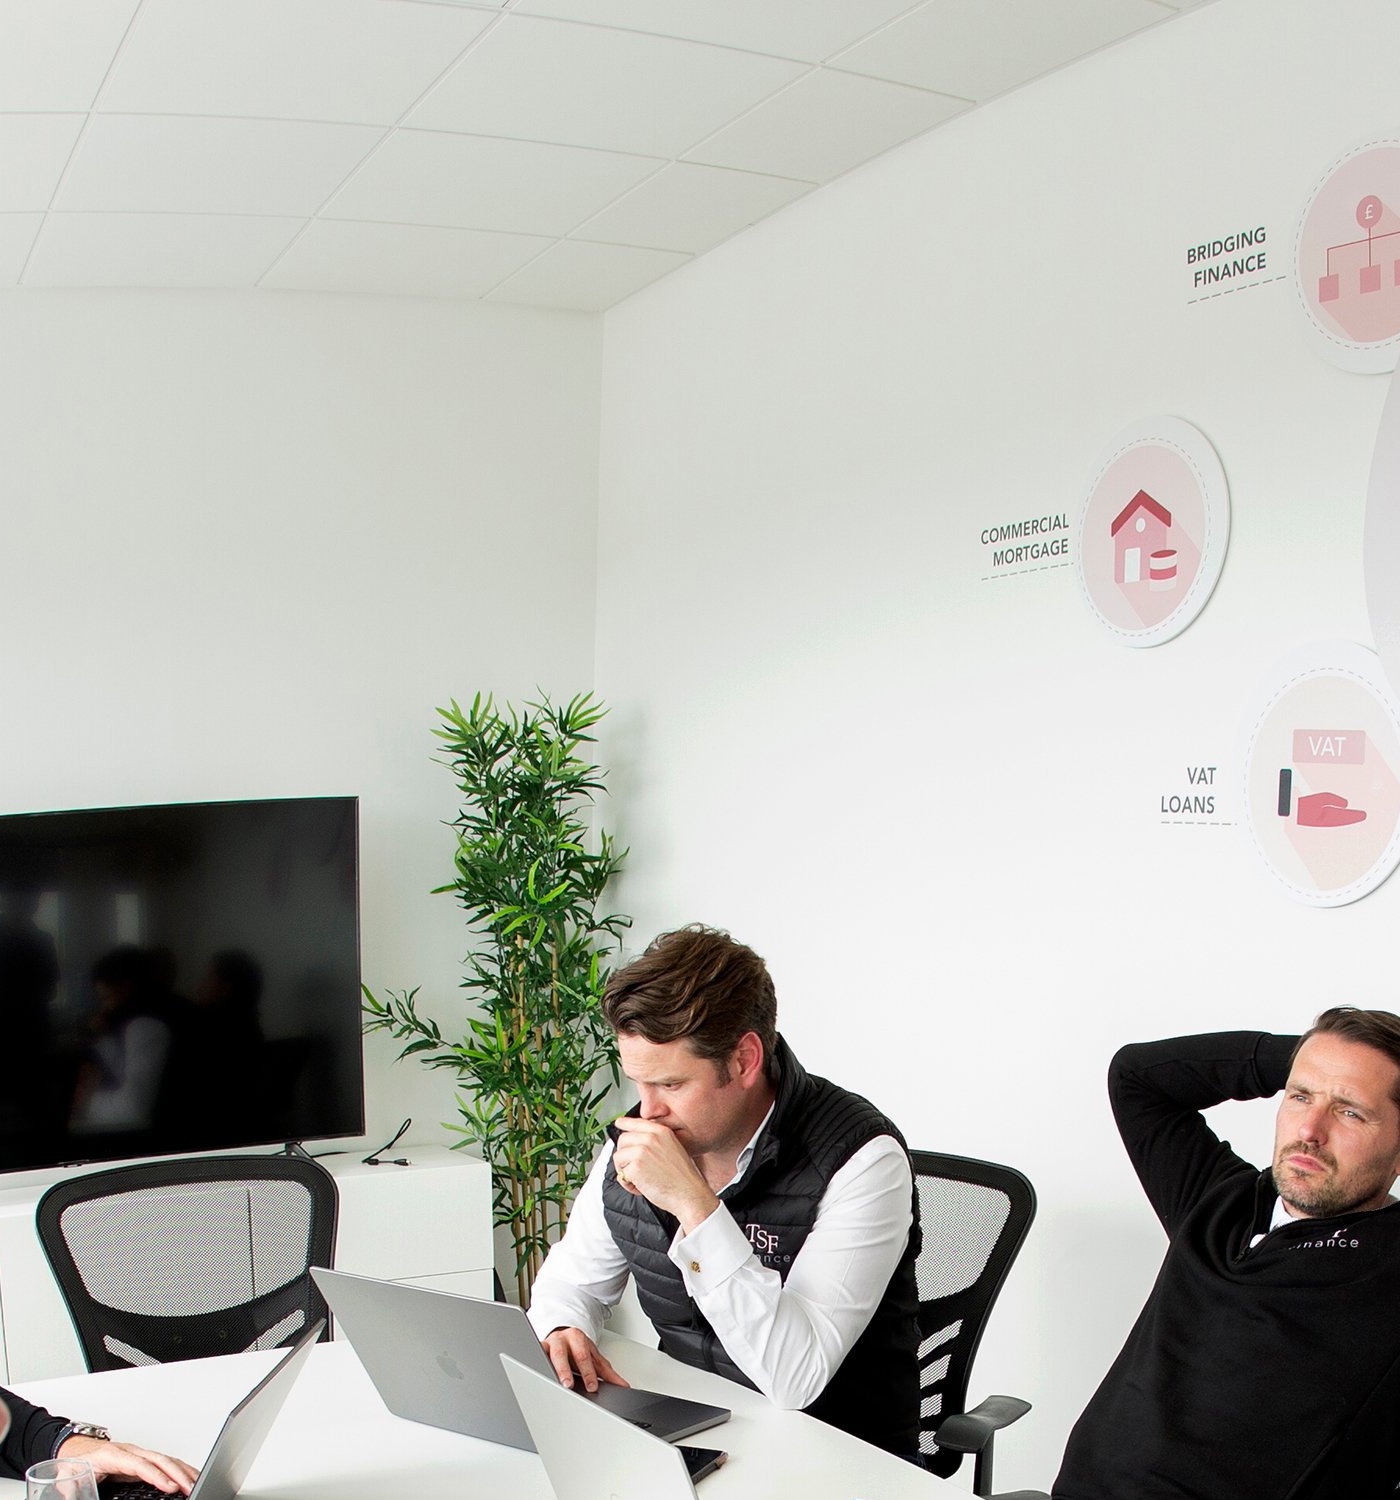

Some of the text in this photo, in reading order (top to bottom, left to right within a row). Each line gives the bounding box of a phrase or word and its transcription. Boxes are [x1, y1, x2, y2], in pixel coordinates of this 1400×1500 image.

[1187, 226, 1267, 264] BRIDGING
[1193, 253, 1267, 288] FINANCE
[980, 513, 1070, 545] COMMERCIAL
[992, 537, 1070, 567] MORTGAGE
[1308, 736, 1347, 757] VAT
[1186, 767, 1217, 786] VAT
[1160, 795, 1216, 815] LOANS
[745, 1223, 779, 1254] TSF
